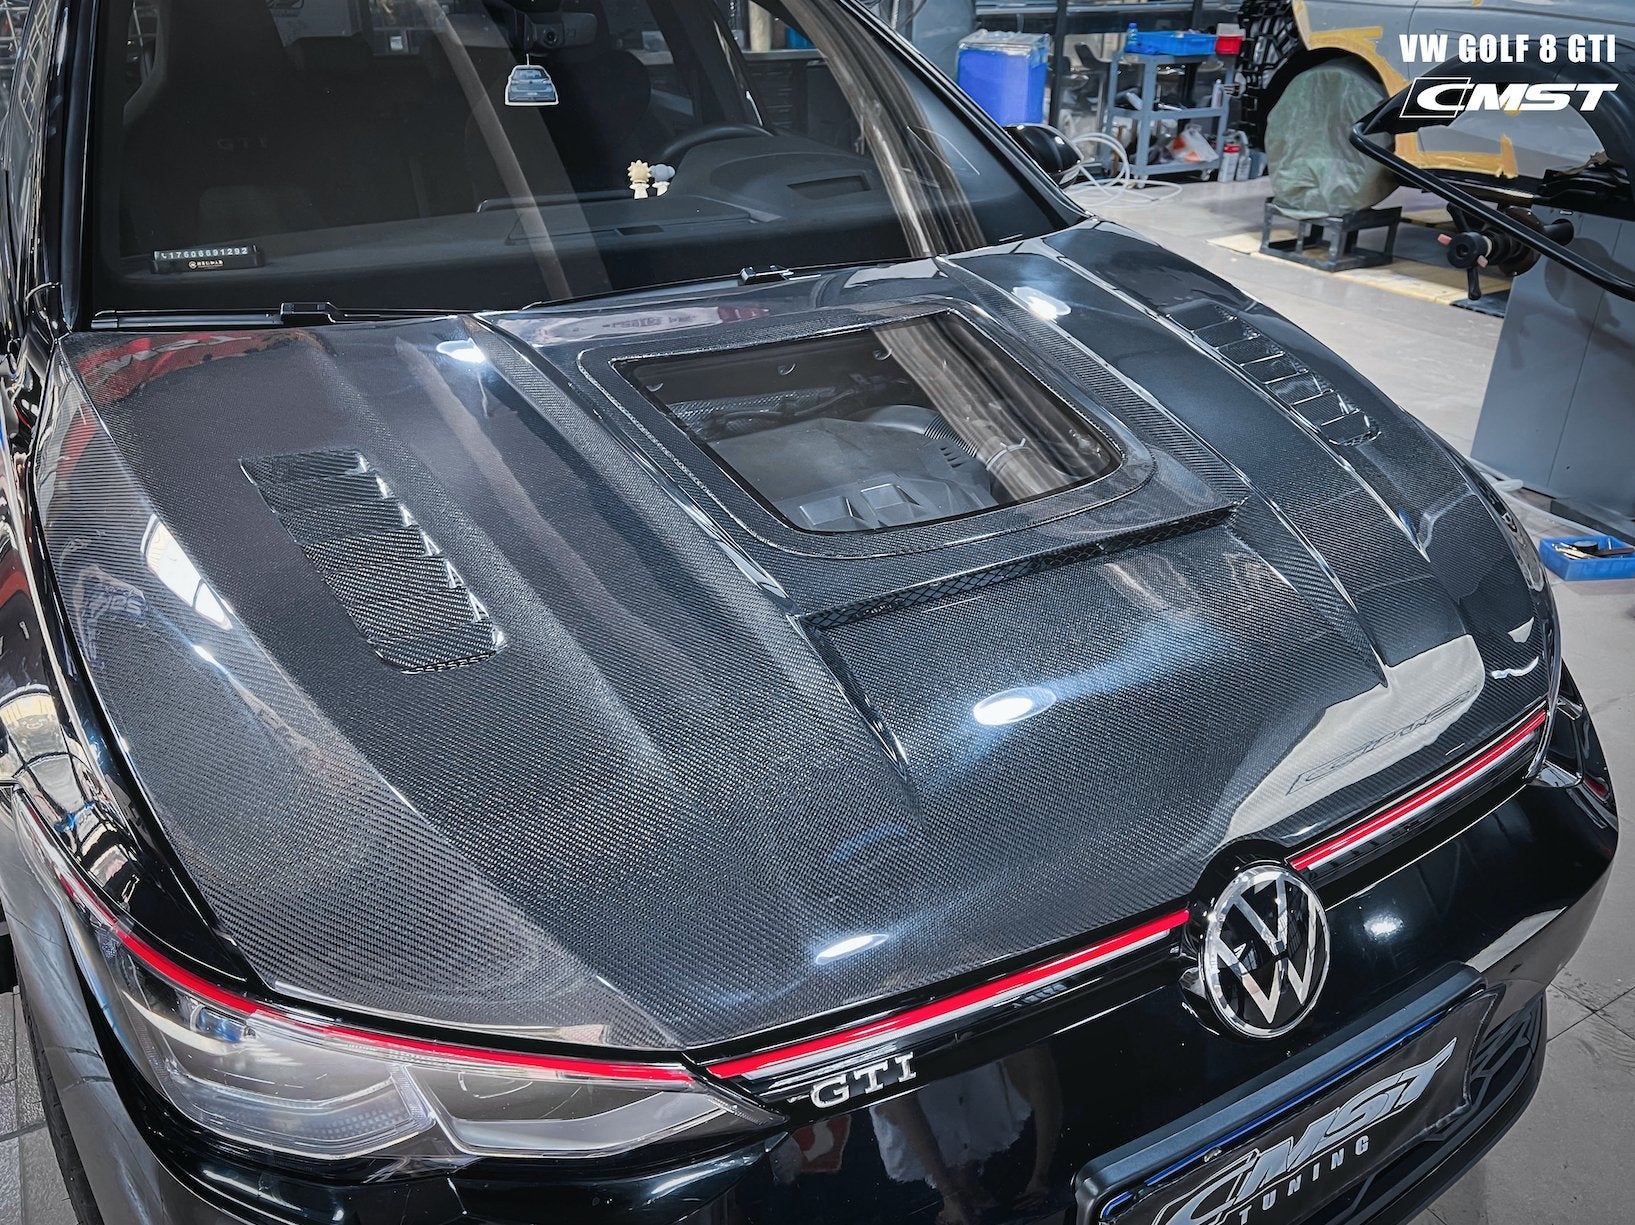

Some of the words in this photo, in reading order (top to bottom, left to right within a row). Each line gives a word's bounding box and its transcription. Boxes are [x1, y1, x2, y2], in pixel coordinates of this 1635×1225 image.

[810, 1051, 917, 1108] GTI
[1156, 1037, 1457, 1225] CMST
[1238, 1135, 1370, 1225] TUNING
